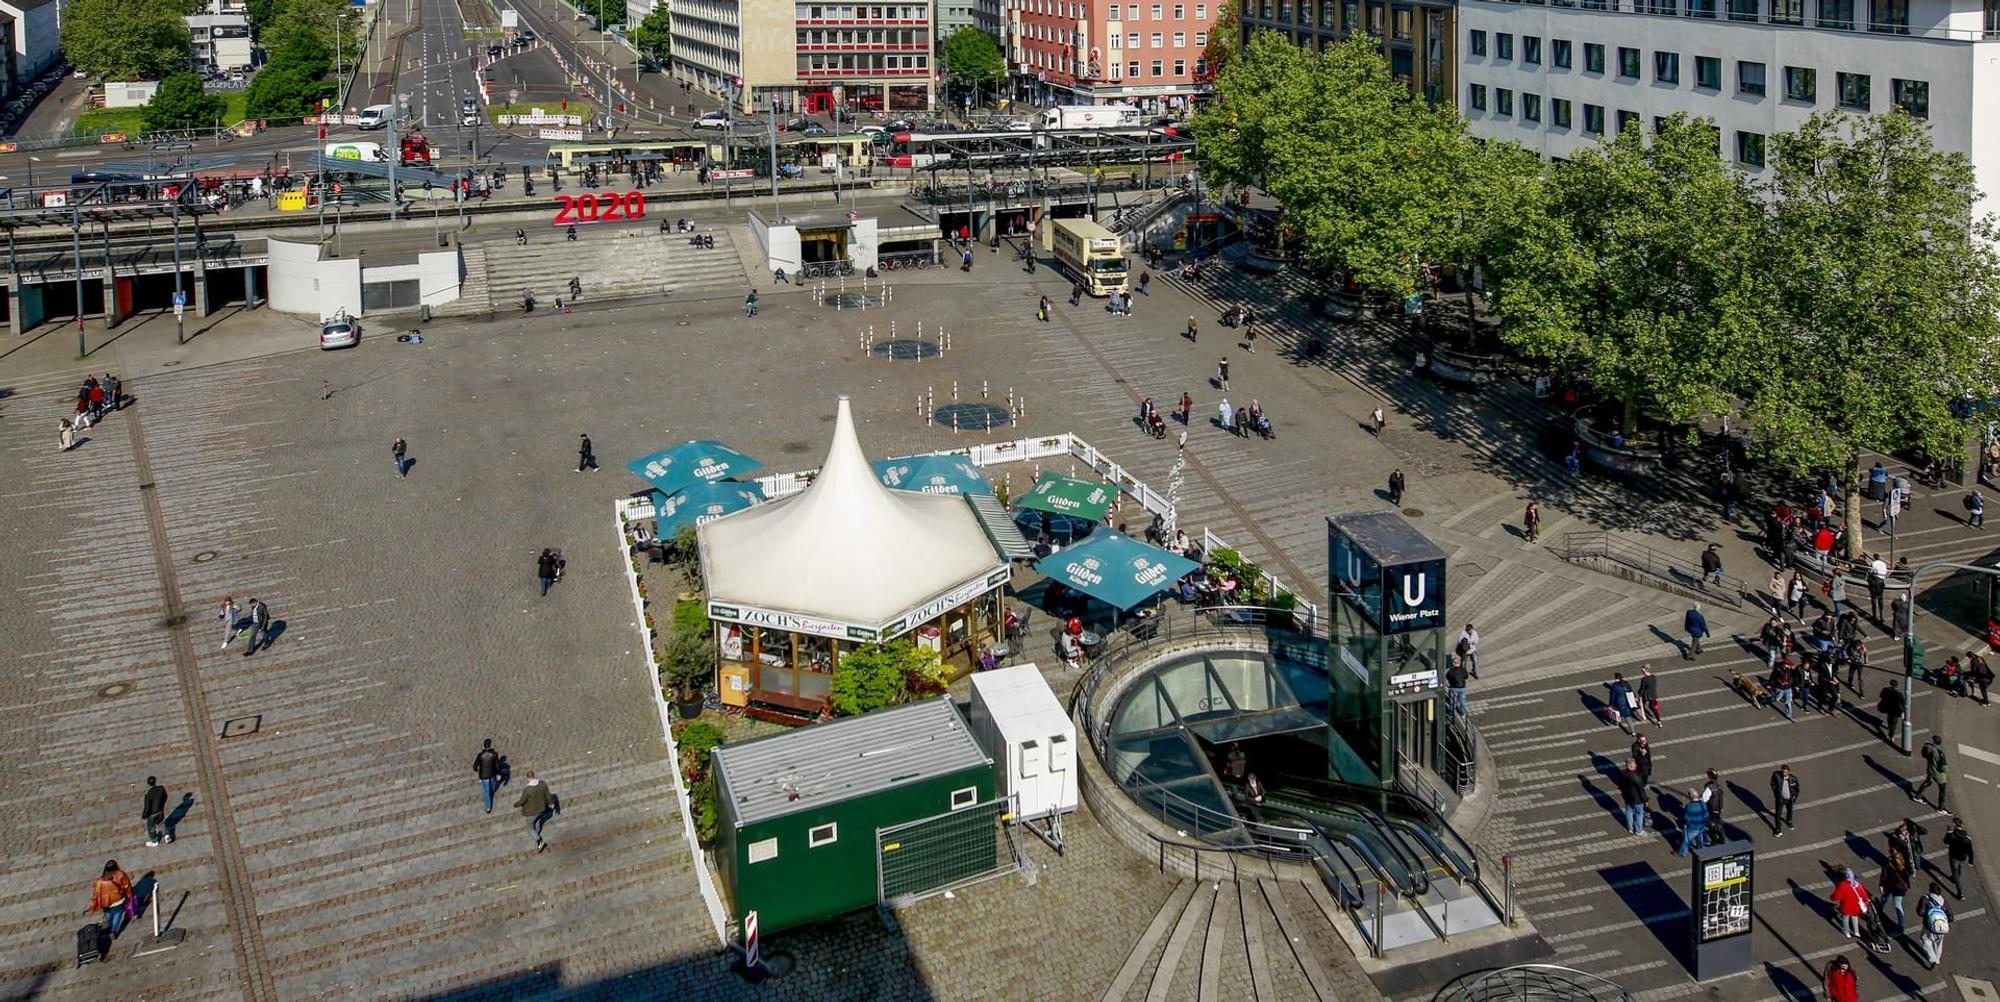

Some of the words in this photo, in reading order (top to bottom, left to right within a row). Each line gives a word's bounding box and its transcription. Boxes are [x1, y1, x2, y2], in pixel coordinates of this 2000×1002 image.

[553, 191, 645, 224] 2020
[693, 461, 730, 477] Gilden
[1047, 495, 1080, 509] Gilden
[1066, 562, 1102, 585] Gilden
[1135, 562, 1167, 585] Gilden
[1404, 573, 1425, 606] U
[744, 610, 801, 628] ZOCH'S
[911, 597, 955, 624] ZOCH'S
[1389, 613, 1417, 622] Wiener
[1420, 609, 1439, 618] Platz
